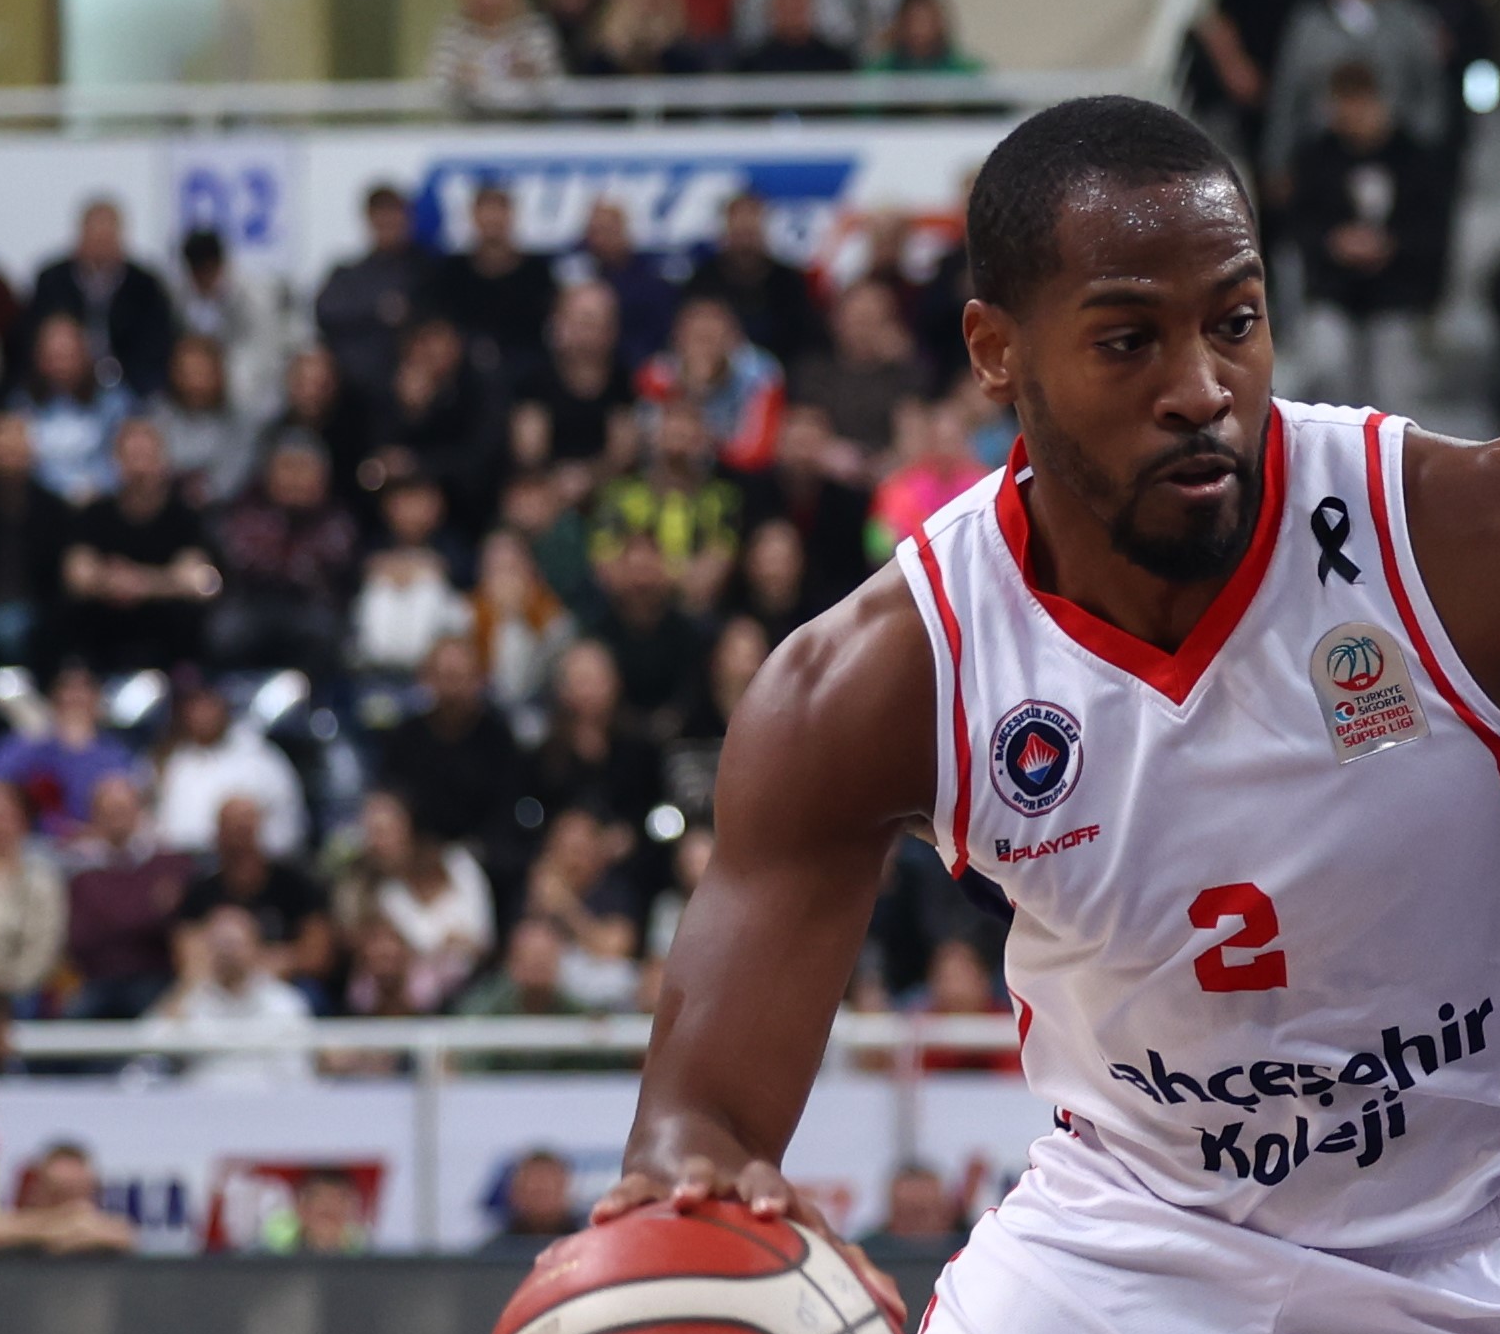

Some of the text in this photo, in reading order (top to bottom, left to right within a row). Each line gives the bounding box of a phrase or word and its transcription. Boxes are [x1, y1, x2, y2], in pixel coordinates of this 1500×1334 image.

[1336, 704, 1414, 736] BASKETBOL
[1013, 824, 1100, 863] PLAYOFF
[1187, 882, 1288, 993] 2
[1105, 997, 1494, 1113] ahçeşehir
[1191, 1085, 1406, 1186] Koleji
